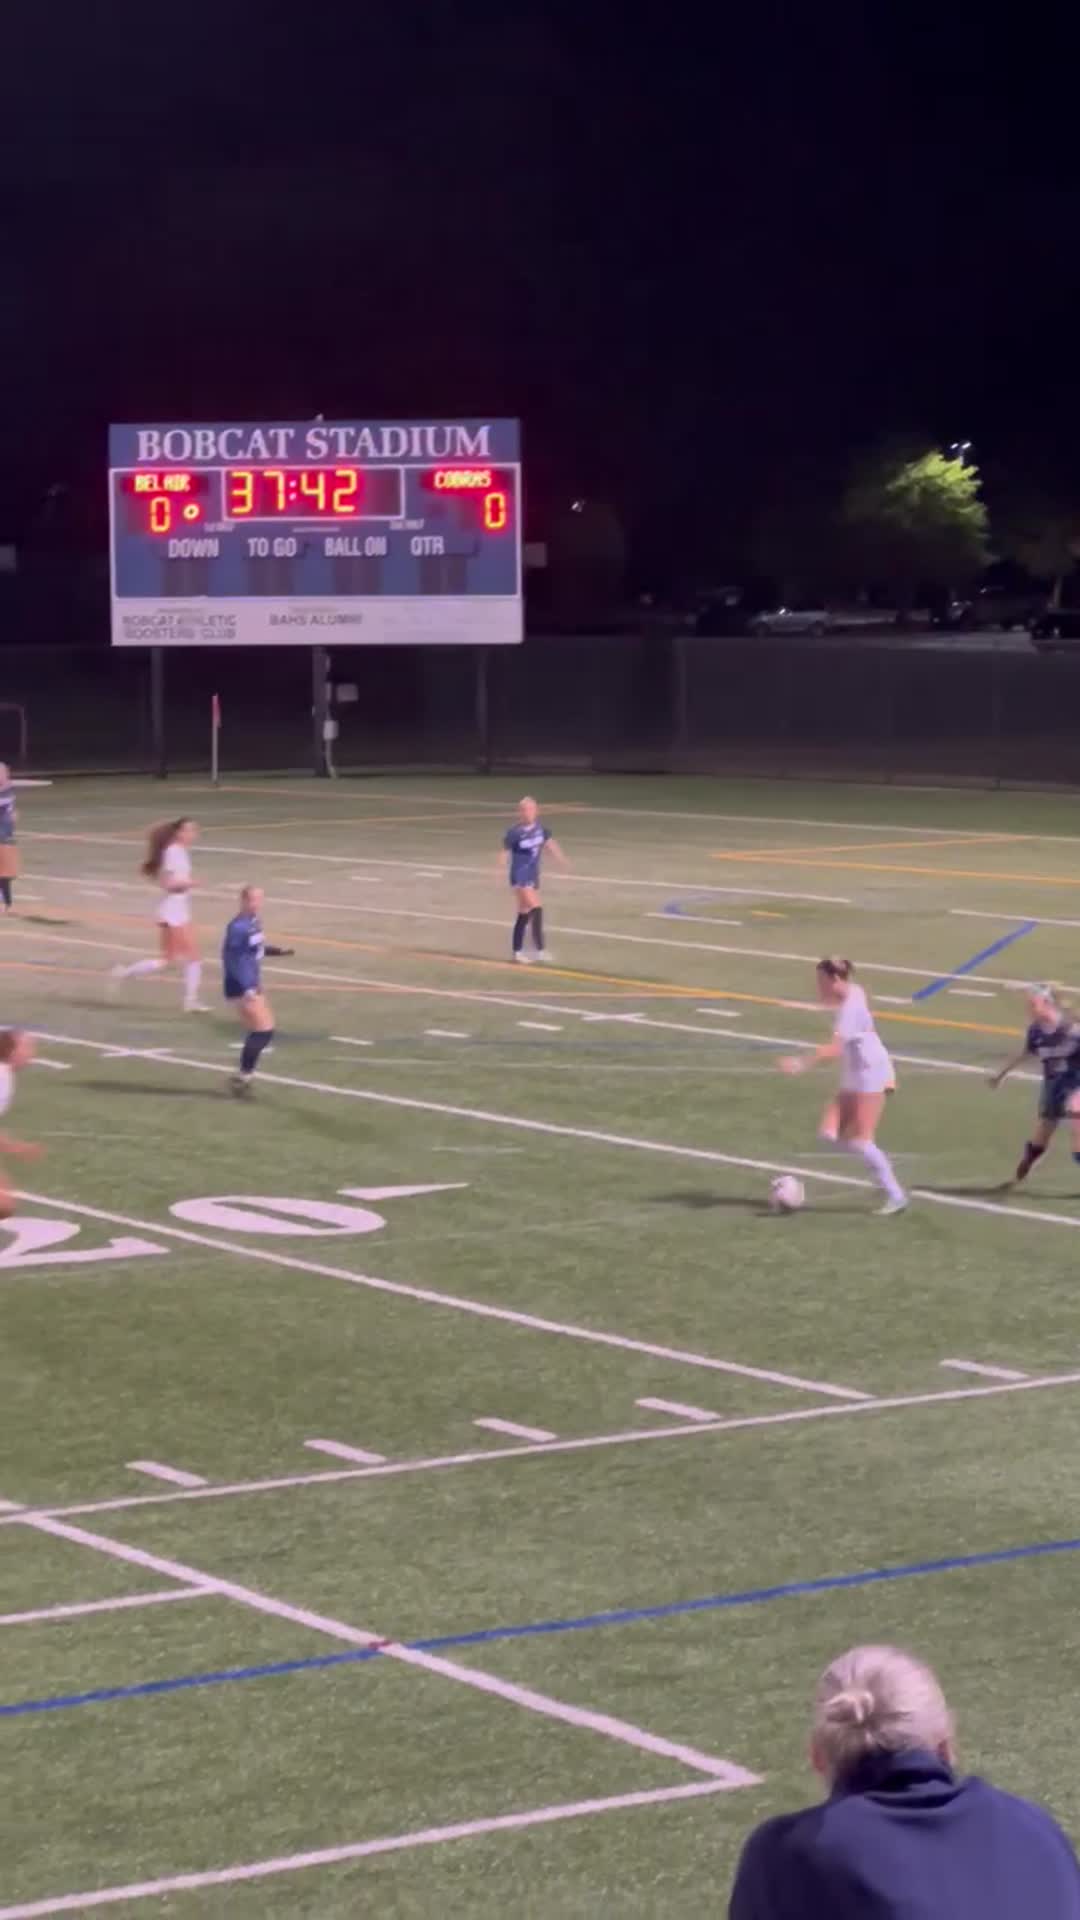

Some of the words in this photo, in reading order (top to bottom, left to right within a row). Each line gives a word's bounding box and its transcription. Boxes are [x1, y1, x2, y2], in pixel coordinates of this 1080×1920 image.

[137, 427, 295, 461] BOBCAT
[305, 424, 492, 458] STADIUM
[231, 469, 358, 514] 37:42
[150, 496, 171, 533] 0
[485, 491, 506, 530] 0
[168, 538, 220, 559] DOWN
[247, 537, 270, 558] TO
[272, 537, 297, 558] GO
[324, 536, 361, 557] BALL
[364, 536, 387, 557] ON
[269, 613, 307, 626] BAHS
